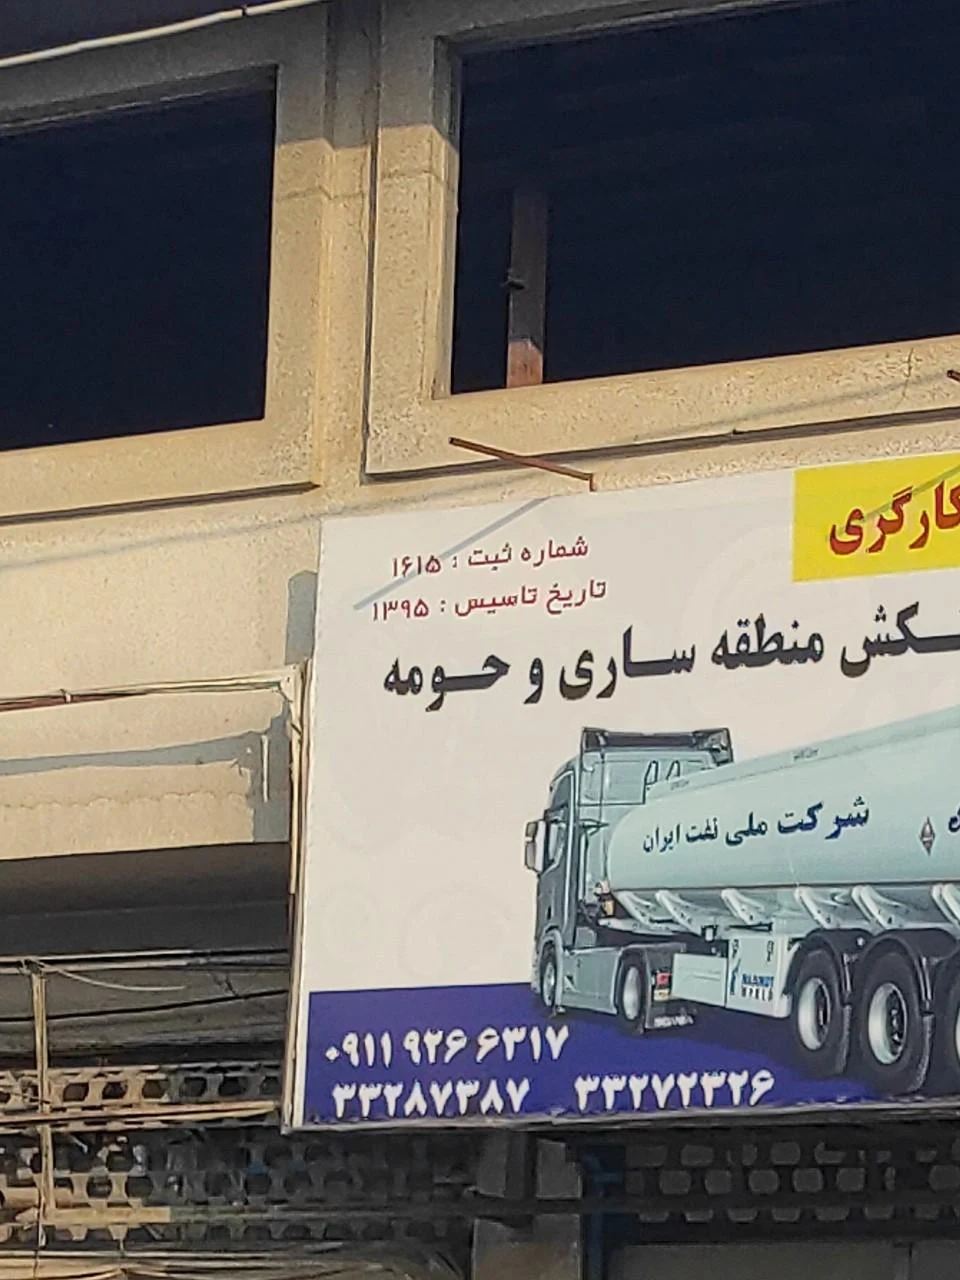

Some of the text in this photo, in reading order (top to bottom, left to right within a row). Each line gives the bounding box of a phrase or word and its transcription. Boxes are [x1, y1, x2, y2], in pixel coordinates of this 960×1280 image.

[392, 554, 442, 580] ۱۶۱۵
[467, 542, 513, 572] ثبت
[520, 536, 589, 568] شماره
[372, 598, 430, 622] ۱۳۹۵
[454, 584, 538, 617] تاسیس
[546, 578, 607, 615] تاریخ
[710, 612, 825, 670] منطقه
[382, 652, 511, 712] حومه
[523, 656, 544, 704] و
[558, 624, 696, 701] ساری
[643, 796, 870, 853] شرکت ملی نفت ایران
[331, 1069, 775, 1119] ۳۳۲۸۷۳۸۷ ۳۳۲۷۲۳۲۶
